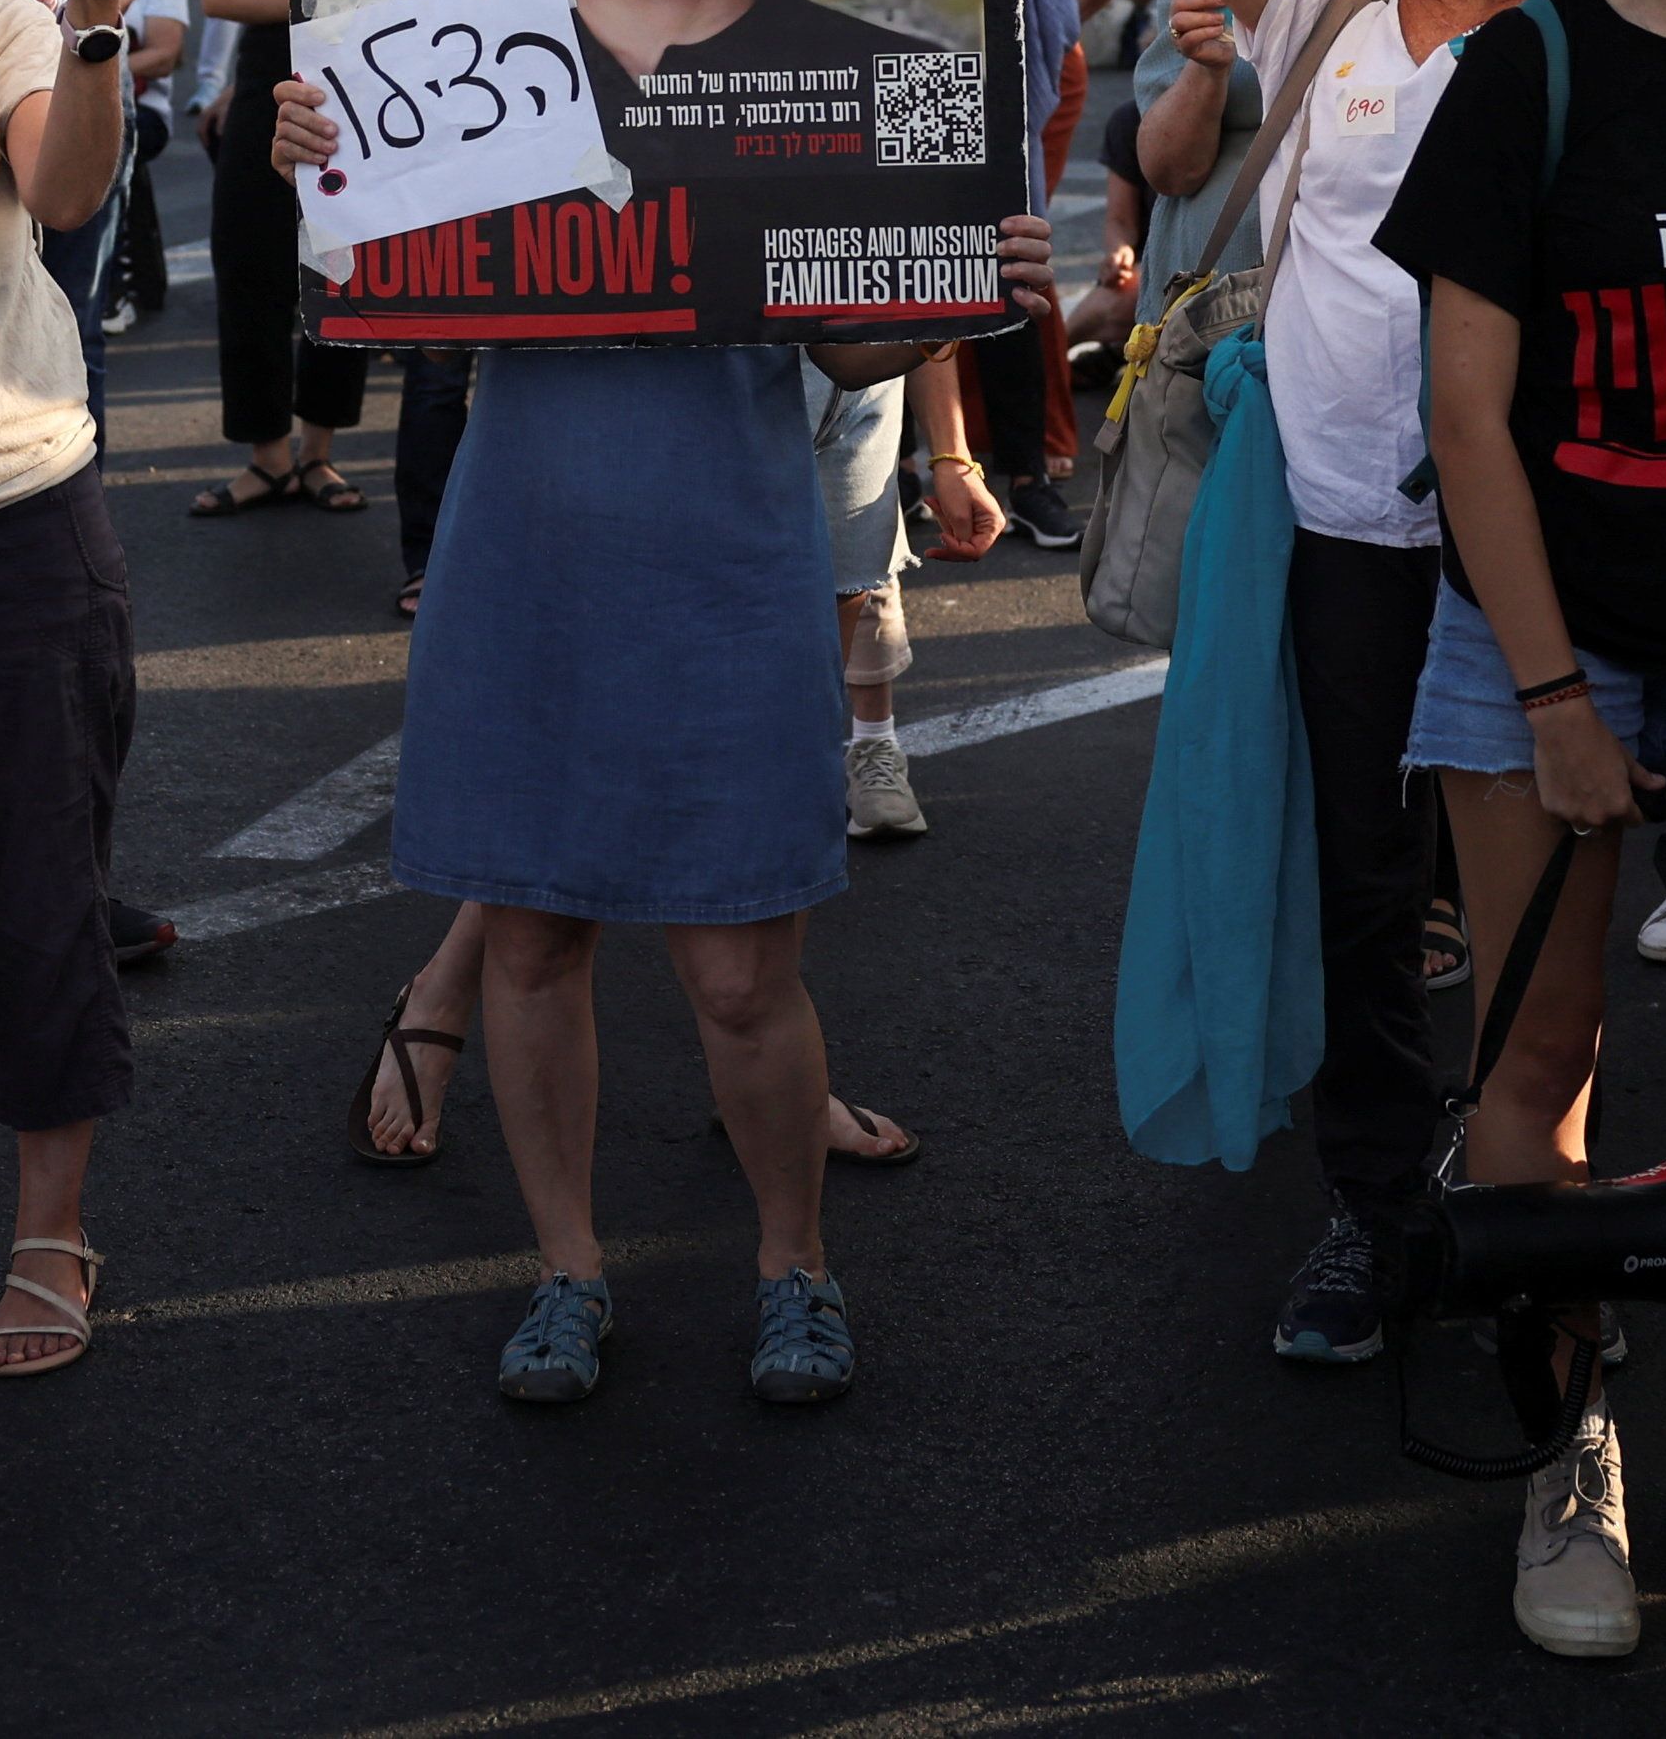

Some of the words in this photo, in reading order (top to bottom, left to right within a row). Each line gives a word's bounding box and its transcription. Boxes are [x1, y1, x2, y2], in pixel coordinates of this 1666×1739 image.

[639, 72, 693, 99] החטוף
[698, 70, 724, 94] של
[729, 70, 793, 94] המהירה
[799, 66, 859, 92] לחזרתו
[666, 105, 702, 127] תמר
[706, 104, 725, 129] בן
[831, 101, 861, 123] רום
[1345, 97, 1386, 125] 690
[734, 134, 777, 157] בבית
[781, 132, 801, 158] לך
[807, 133, 861, 155] מחכים
[514, 187, 691, 297] NOW!
[764, 228, 864, 261] HOSTAGES
[866, 227, 907, 257] AND
[909, 224, 997, 257] MISSING
[765, 262, 893, 307] FAMILIES
[898, 259, 999, 304] FORUM
